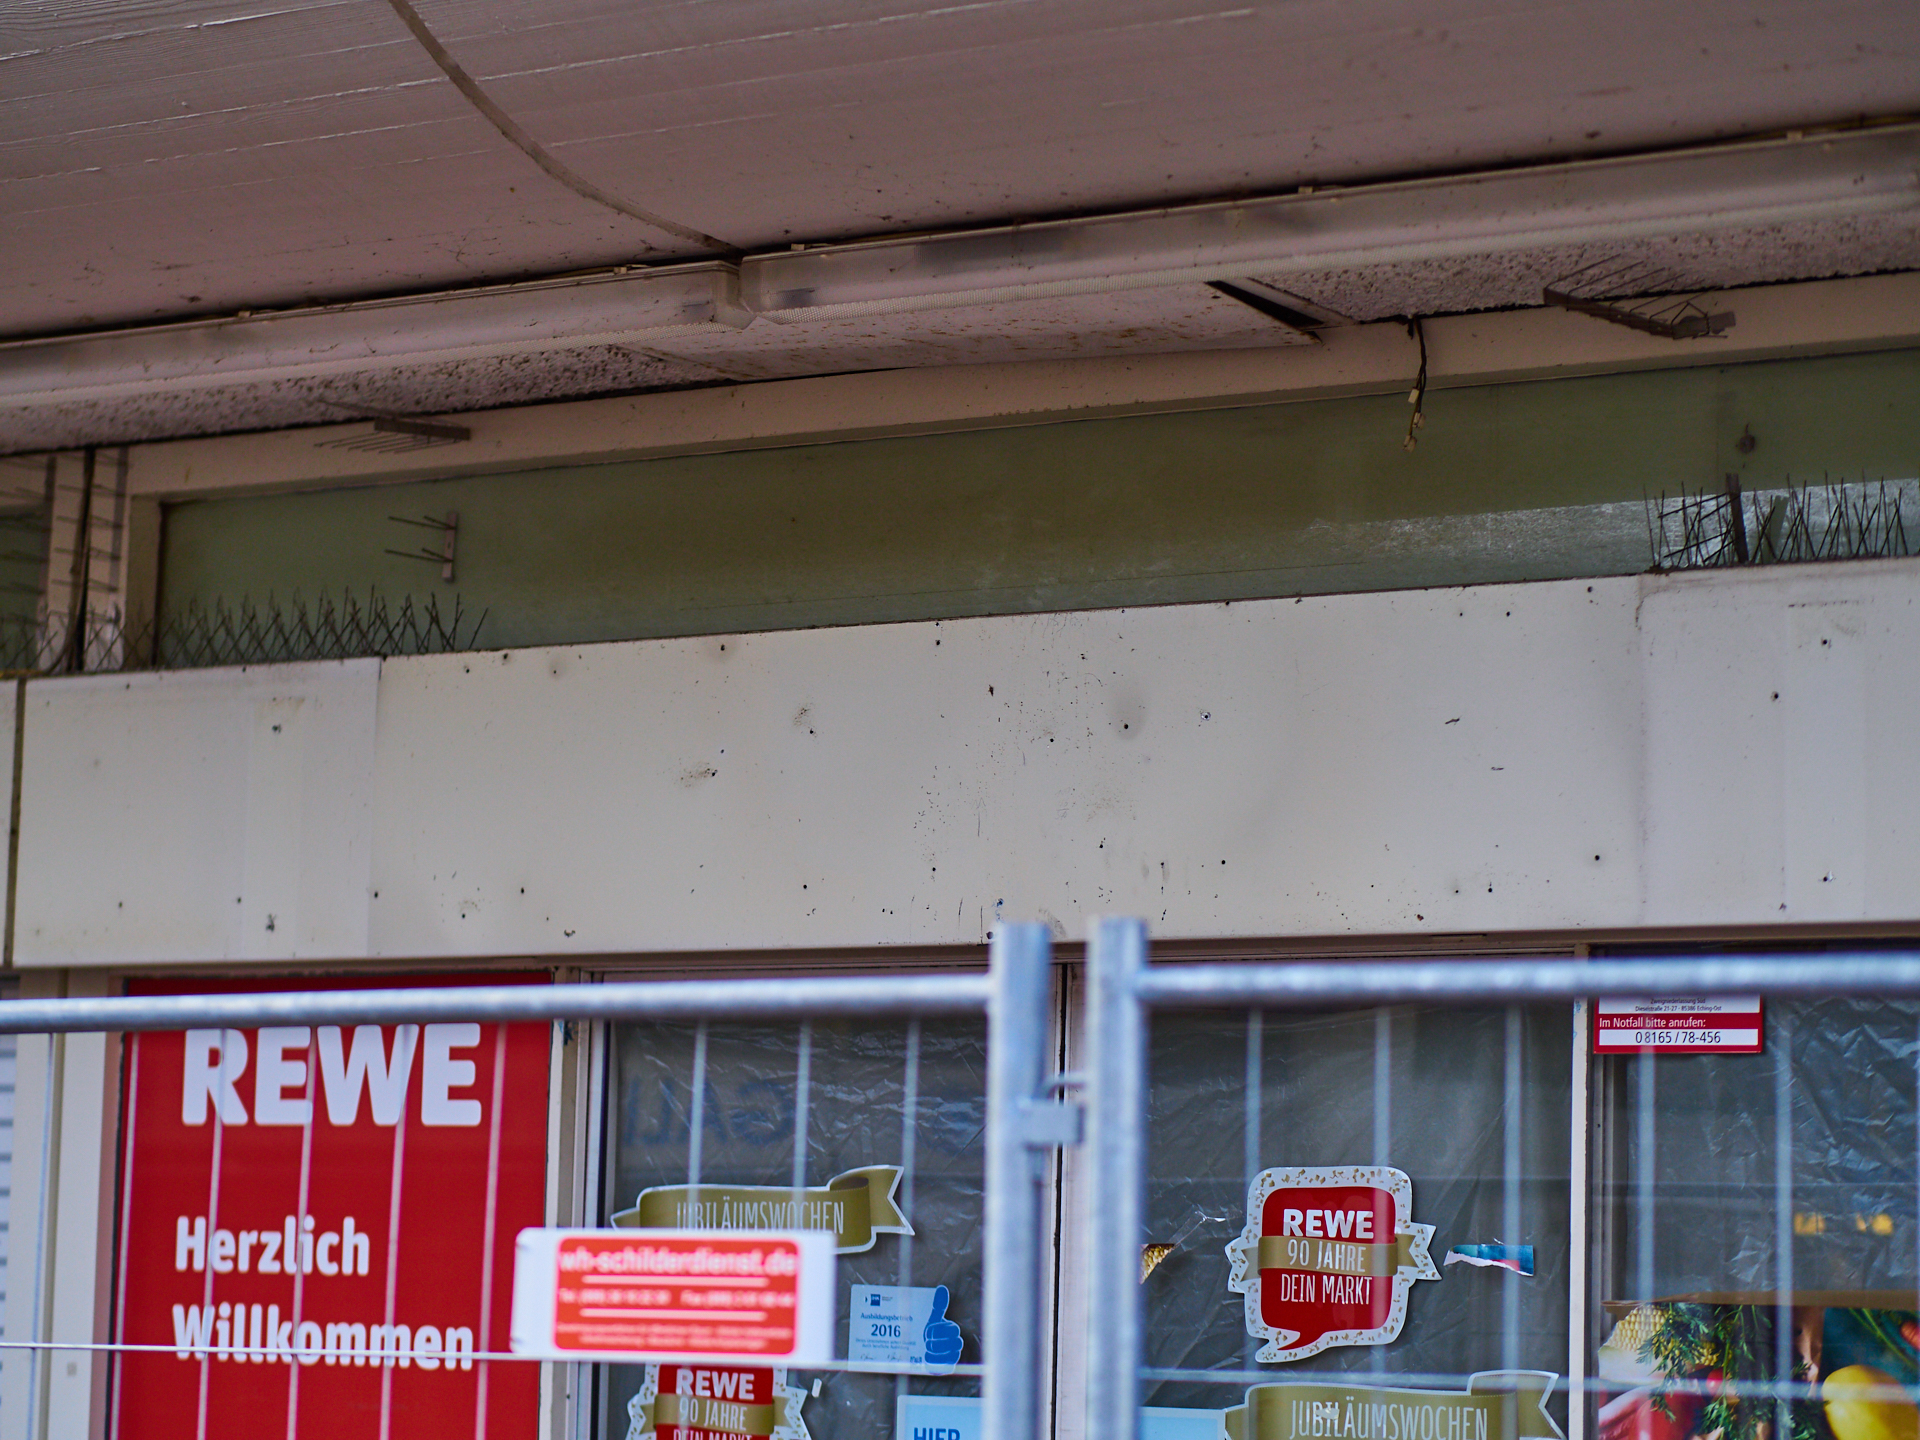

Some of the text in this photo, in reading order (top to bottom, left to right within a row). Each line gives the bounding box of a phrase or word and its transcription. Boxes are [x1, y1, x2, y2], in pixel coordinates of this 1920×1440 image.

[1599, 1016, 1706, 1028] Im Notfall bitte anrufen:
[181, 1022, 483, 1127] REWE
[676, 1195, 844, 1234] JUBILÄUMSWOCHEN
[1283, 1208, 1374, 1239] REWE
[174, 1214, 370, 1276] Herzlich
[1287, 1239, 1366, 1272] 90 JAHRE
[1281, 1273, 1373, 1305] DEIN MARKT
[171, 1302, 475, 1371] Willkommen
[870, 1323, 901, 1338] 2016
[675, 1368, 756, 1401] REWE
[679, 1397, 748, 1431] 90 JAHRE
[1289, 1396, 1488, 1440] JUBILÄUMSWOCHEN
